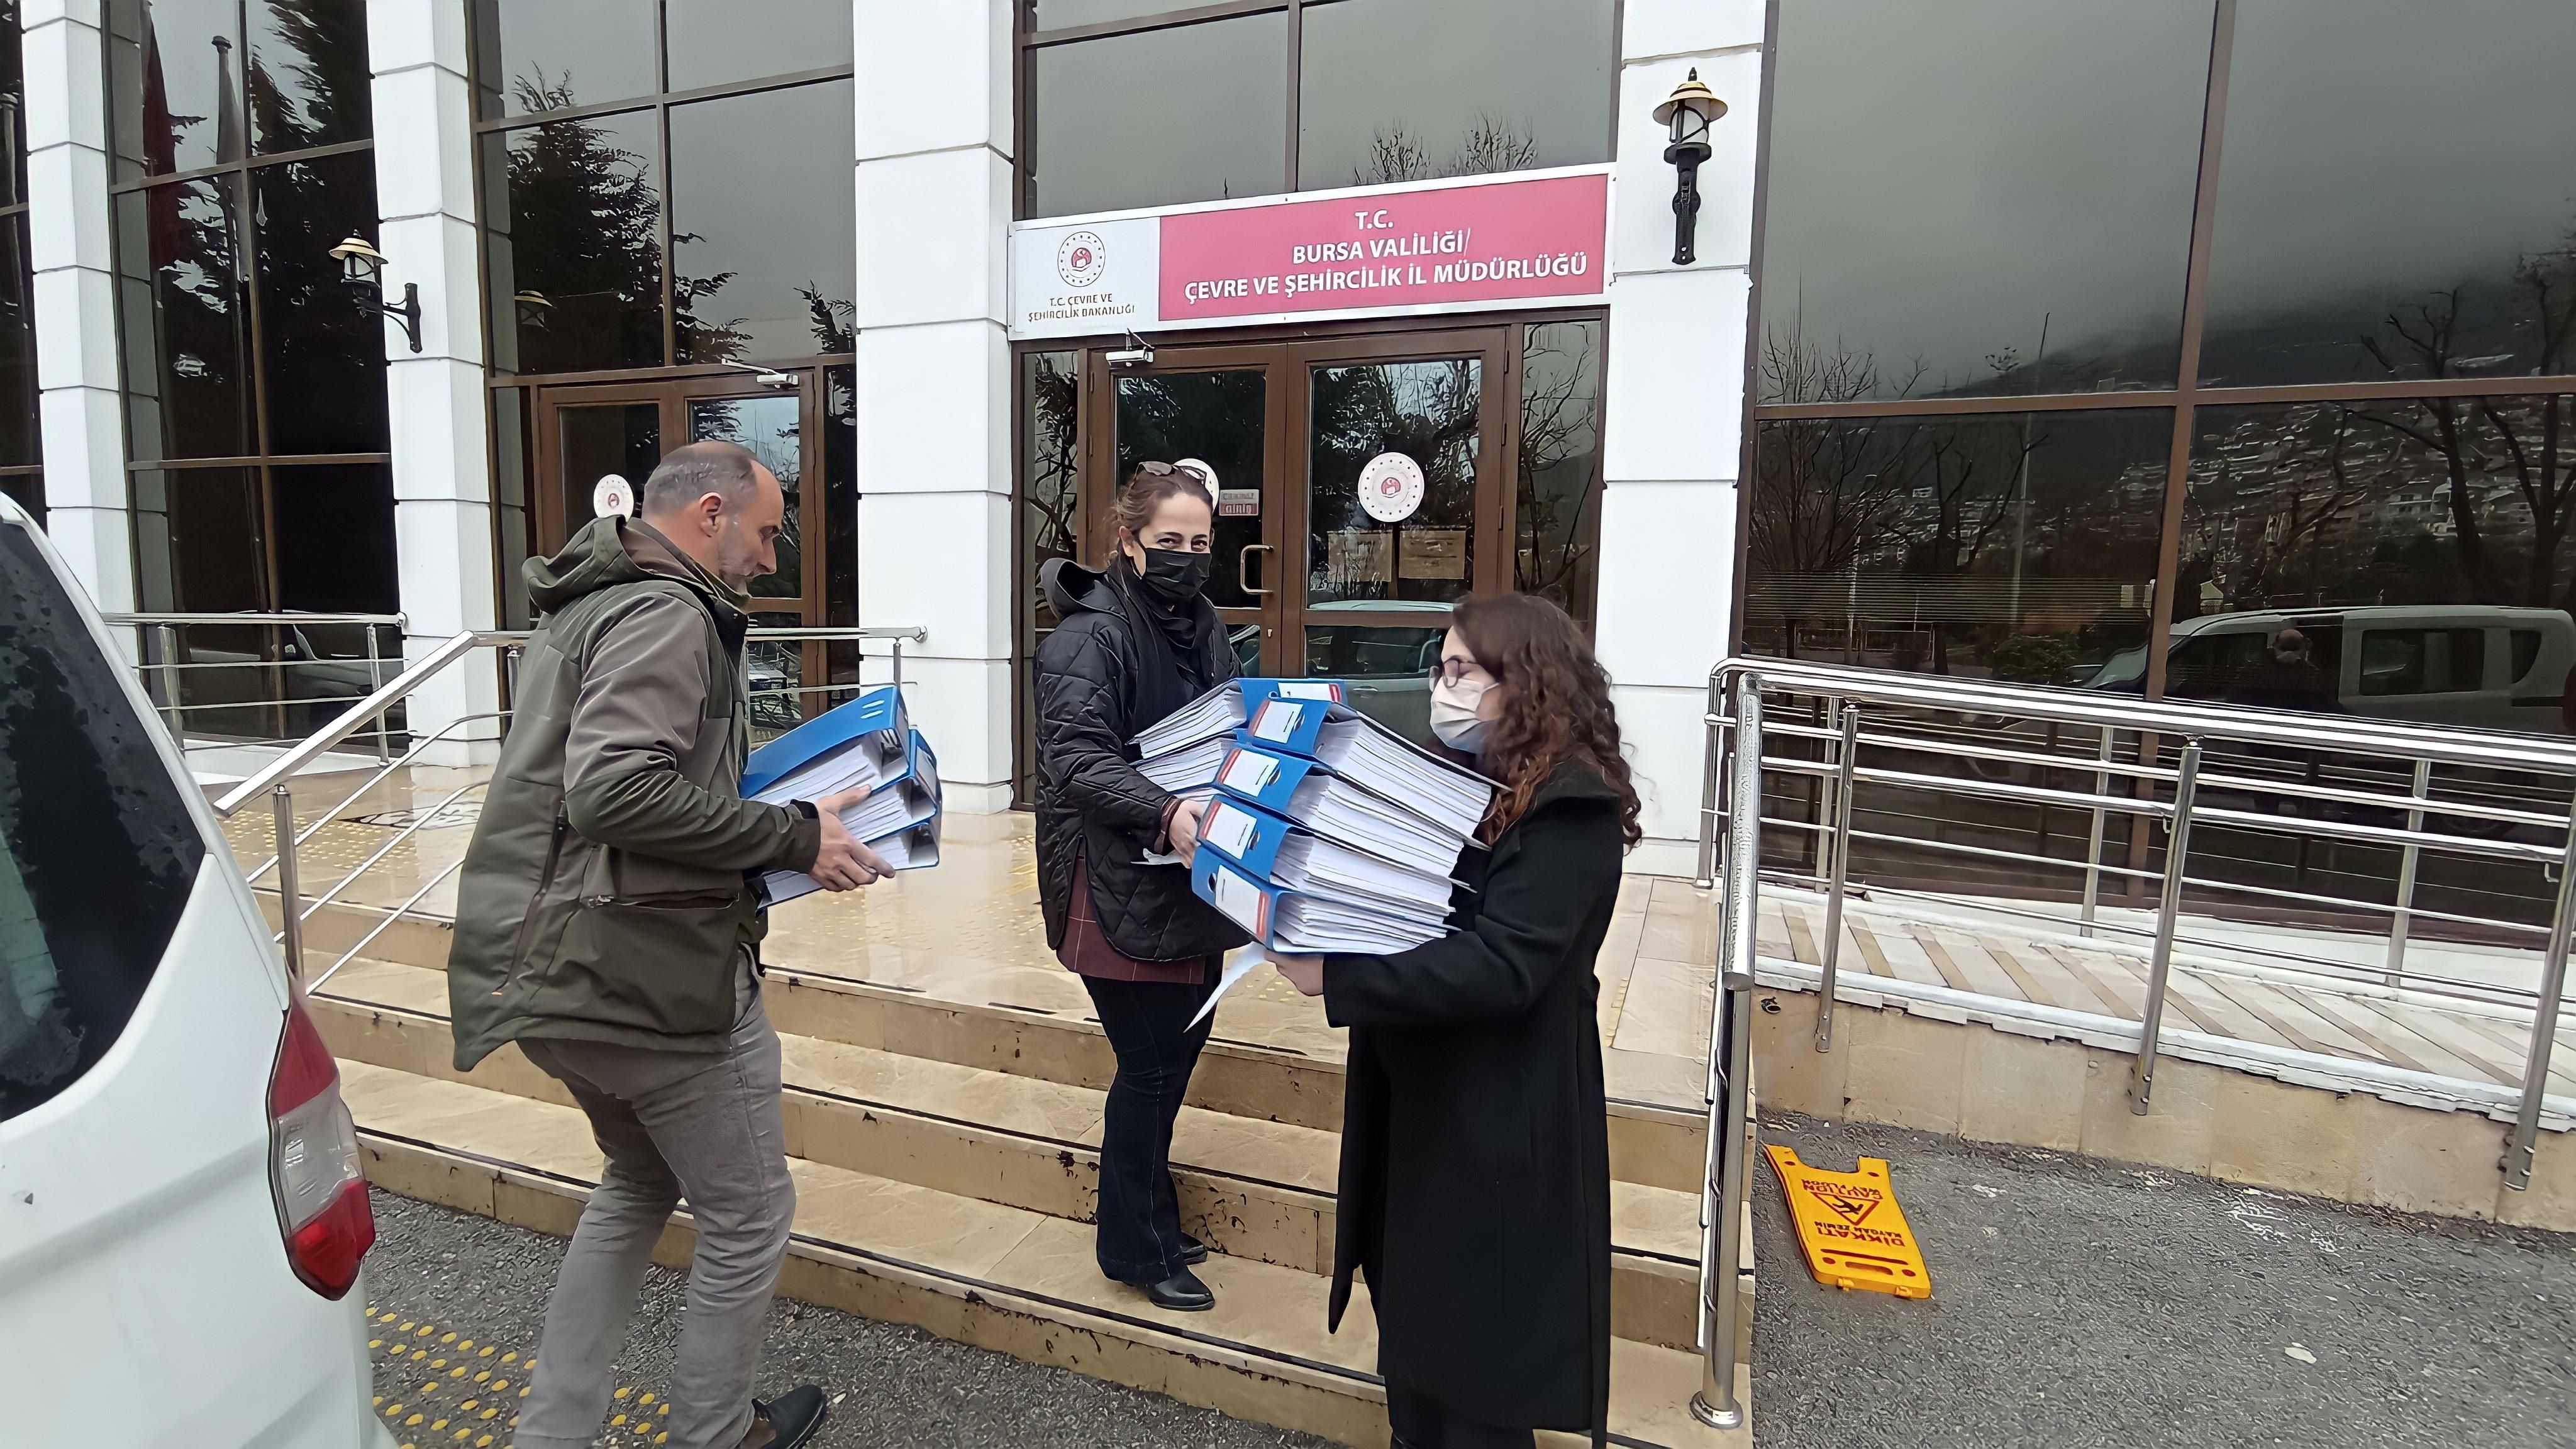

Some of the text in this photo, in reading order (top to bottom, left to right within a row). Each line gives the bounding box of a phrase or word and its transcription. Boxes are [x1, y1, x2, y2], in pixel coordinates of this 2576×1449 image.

[1355, 209, 1394, 230] T.C.
[1292, 241, 1363, 264] BURSA
[1184, 251, 1587, 304] ÇEVRE VE ŞEHİRCİLİK İL MÜDÜRLÜĞÜ
[1101, 293, 1113, 303] VE
